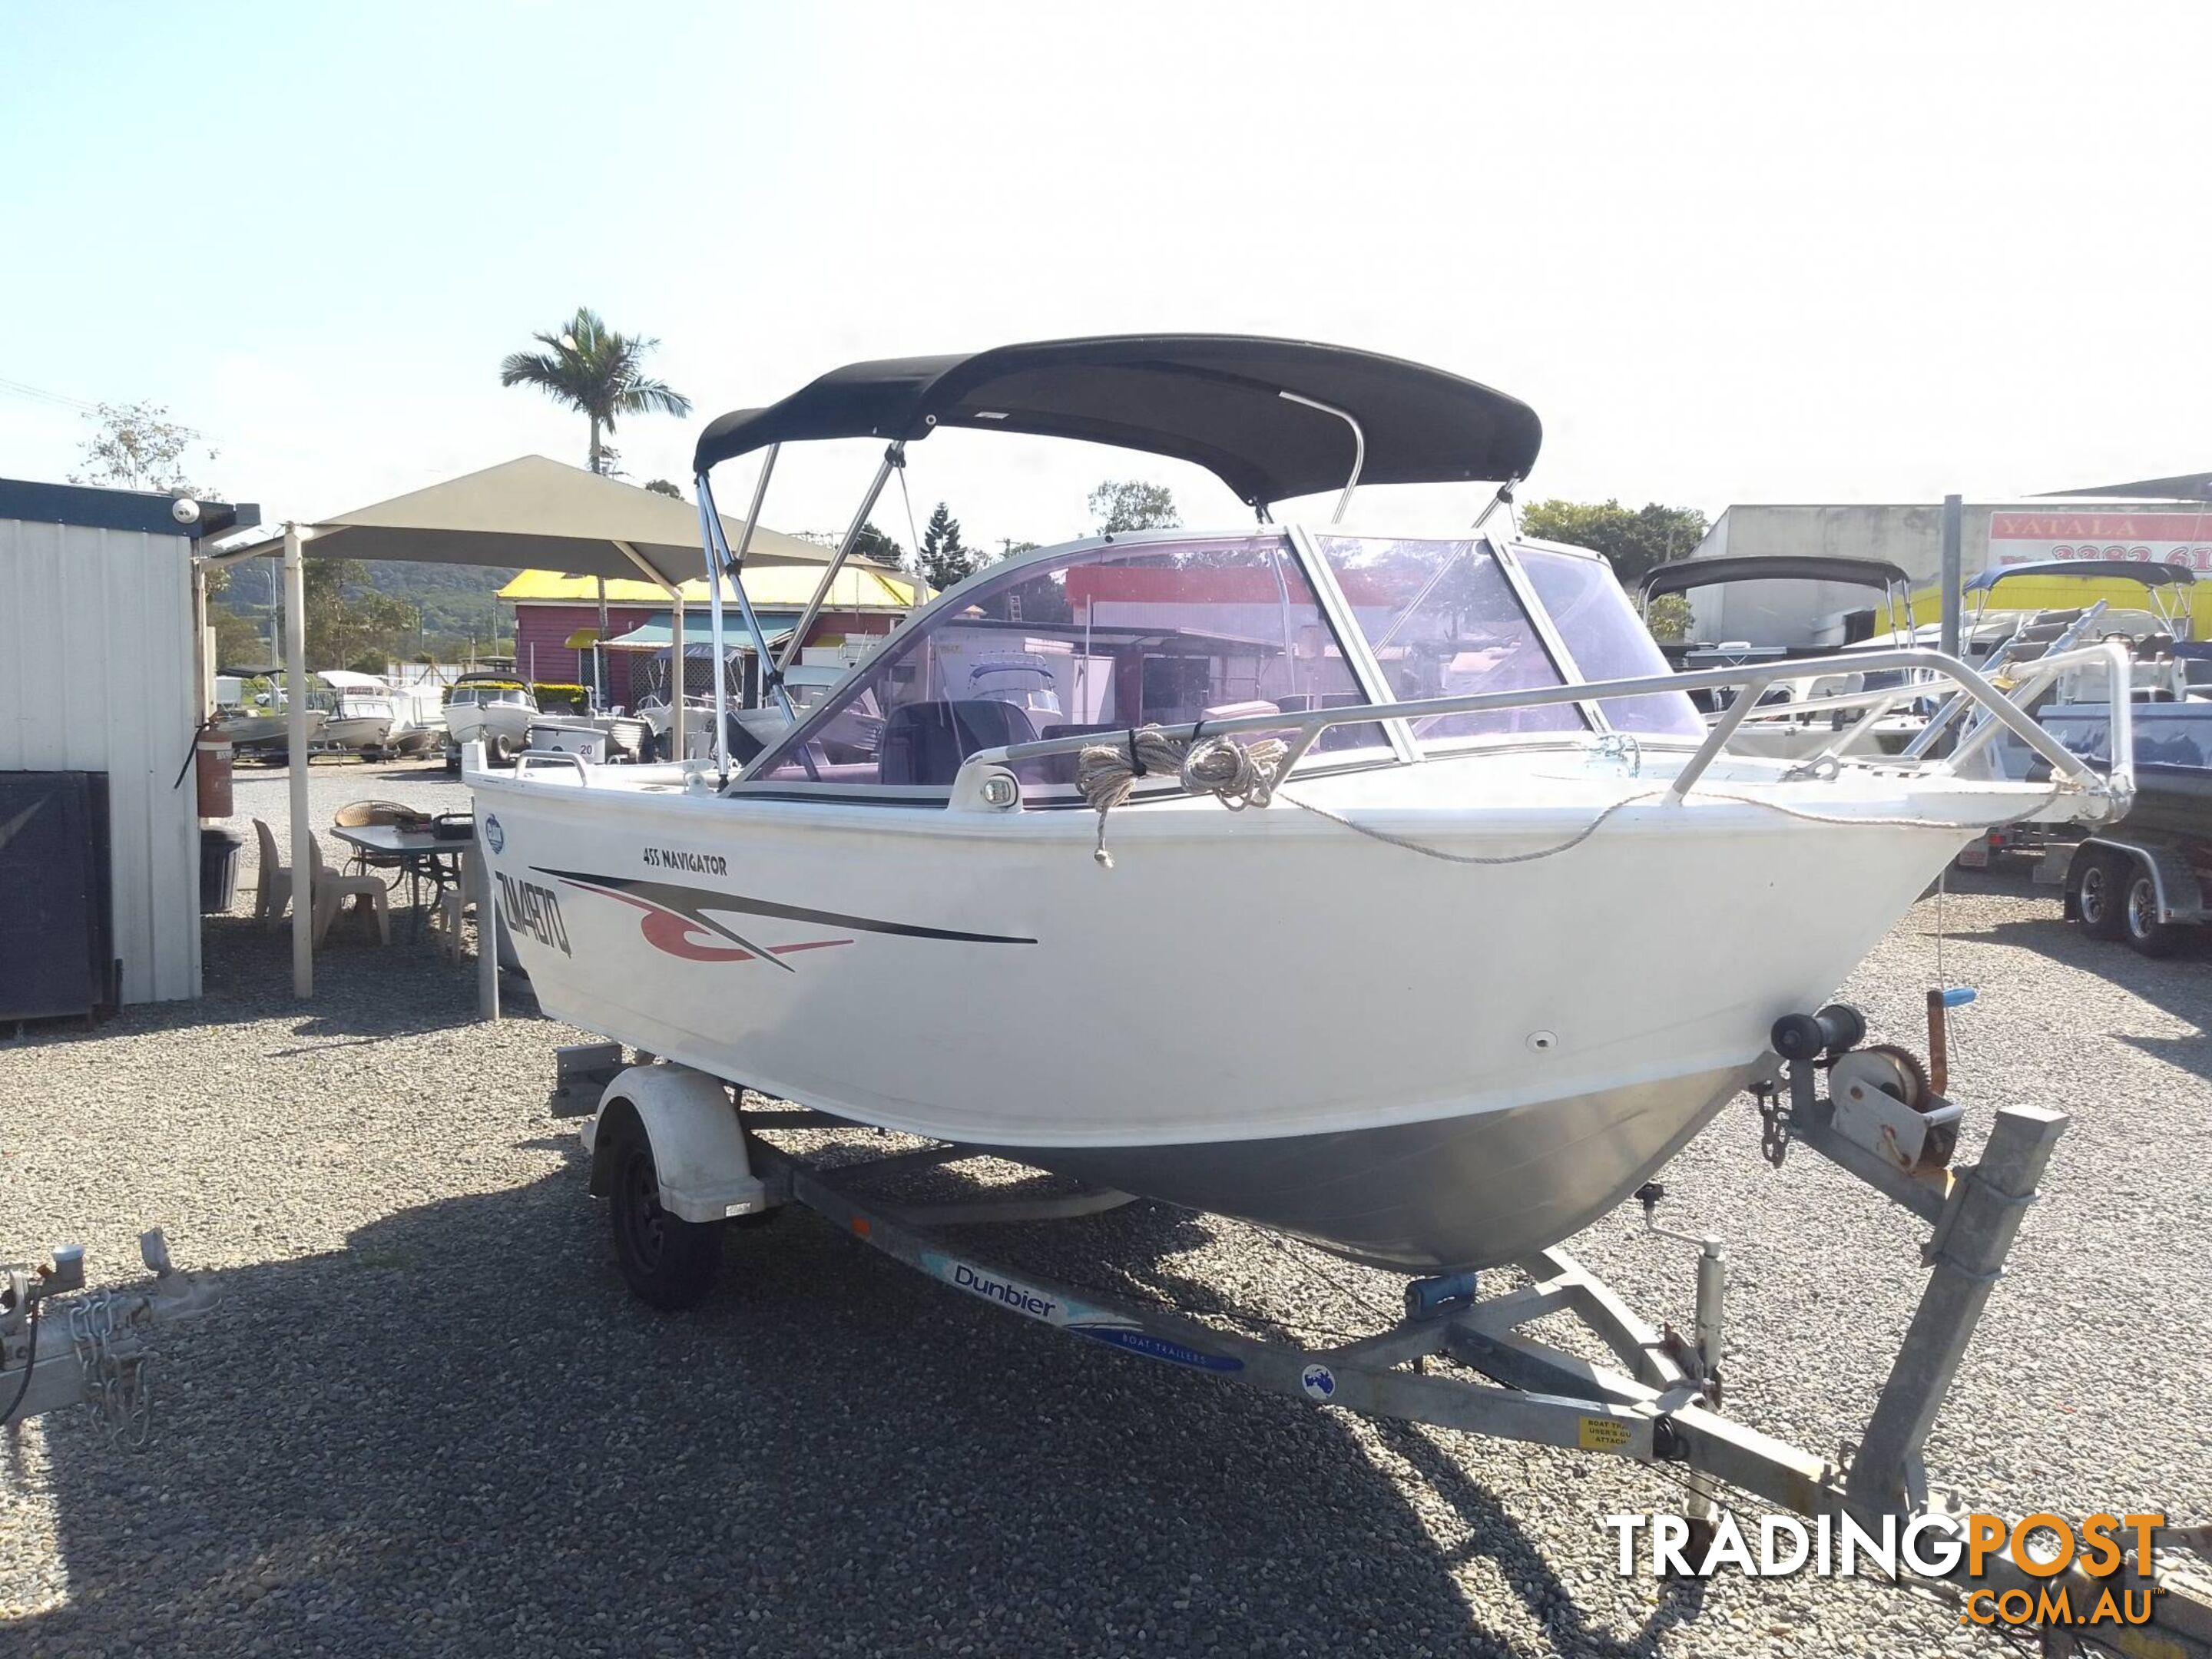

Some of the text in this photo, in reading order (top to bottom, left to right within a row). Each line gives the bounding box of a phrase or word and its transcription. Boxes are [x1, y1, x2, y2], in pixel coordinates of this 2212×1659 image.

[2003, 519, 2137, 535] YATALA
[580, 745, 593, 755] 20
[644, 848, 727, 876] 455 NAVIGATOR
[955, 1265, 1056, 1317] Dunbier
[1122, 1333, 1207, 1365] BOAT TRAILERS
